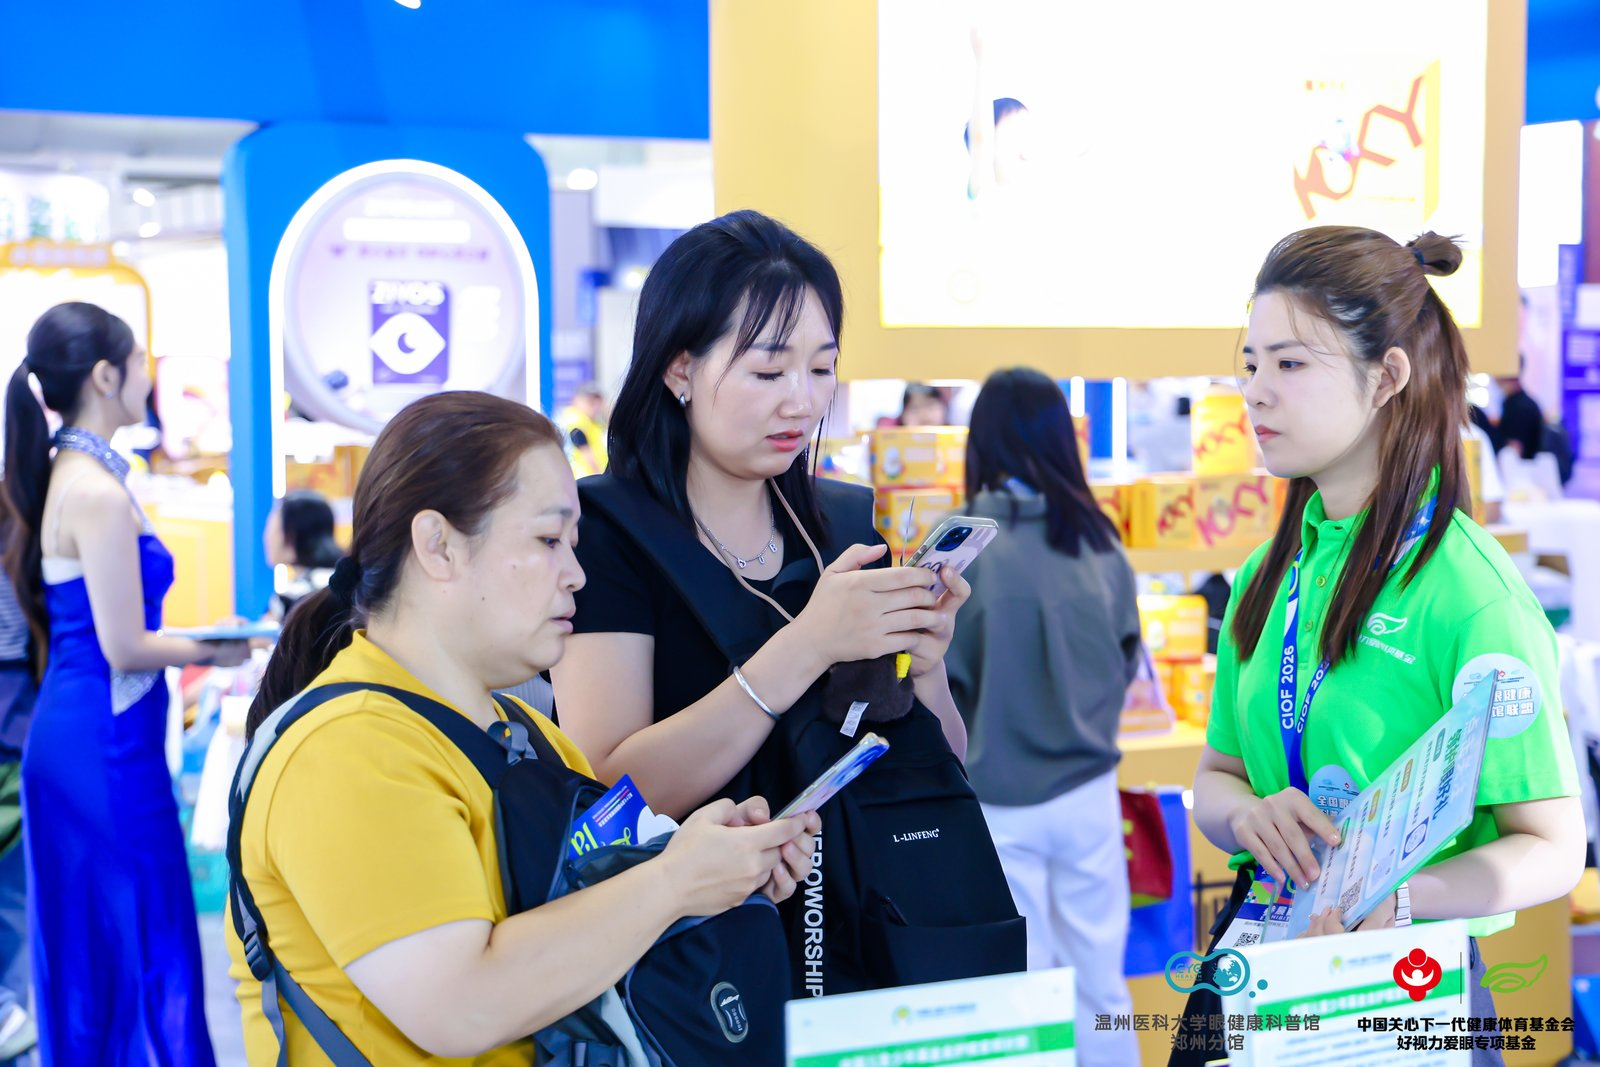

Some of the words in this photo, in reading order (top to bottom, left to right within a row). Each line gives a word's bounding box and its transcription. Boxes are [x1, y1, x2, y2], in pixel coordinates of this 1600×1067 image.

[1282, 645, 1294, 684] 2026
[1281, 690, 1294, 729] CIOF
[1296, 693, 1311, 733] CIOF
